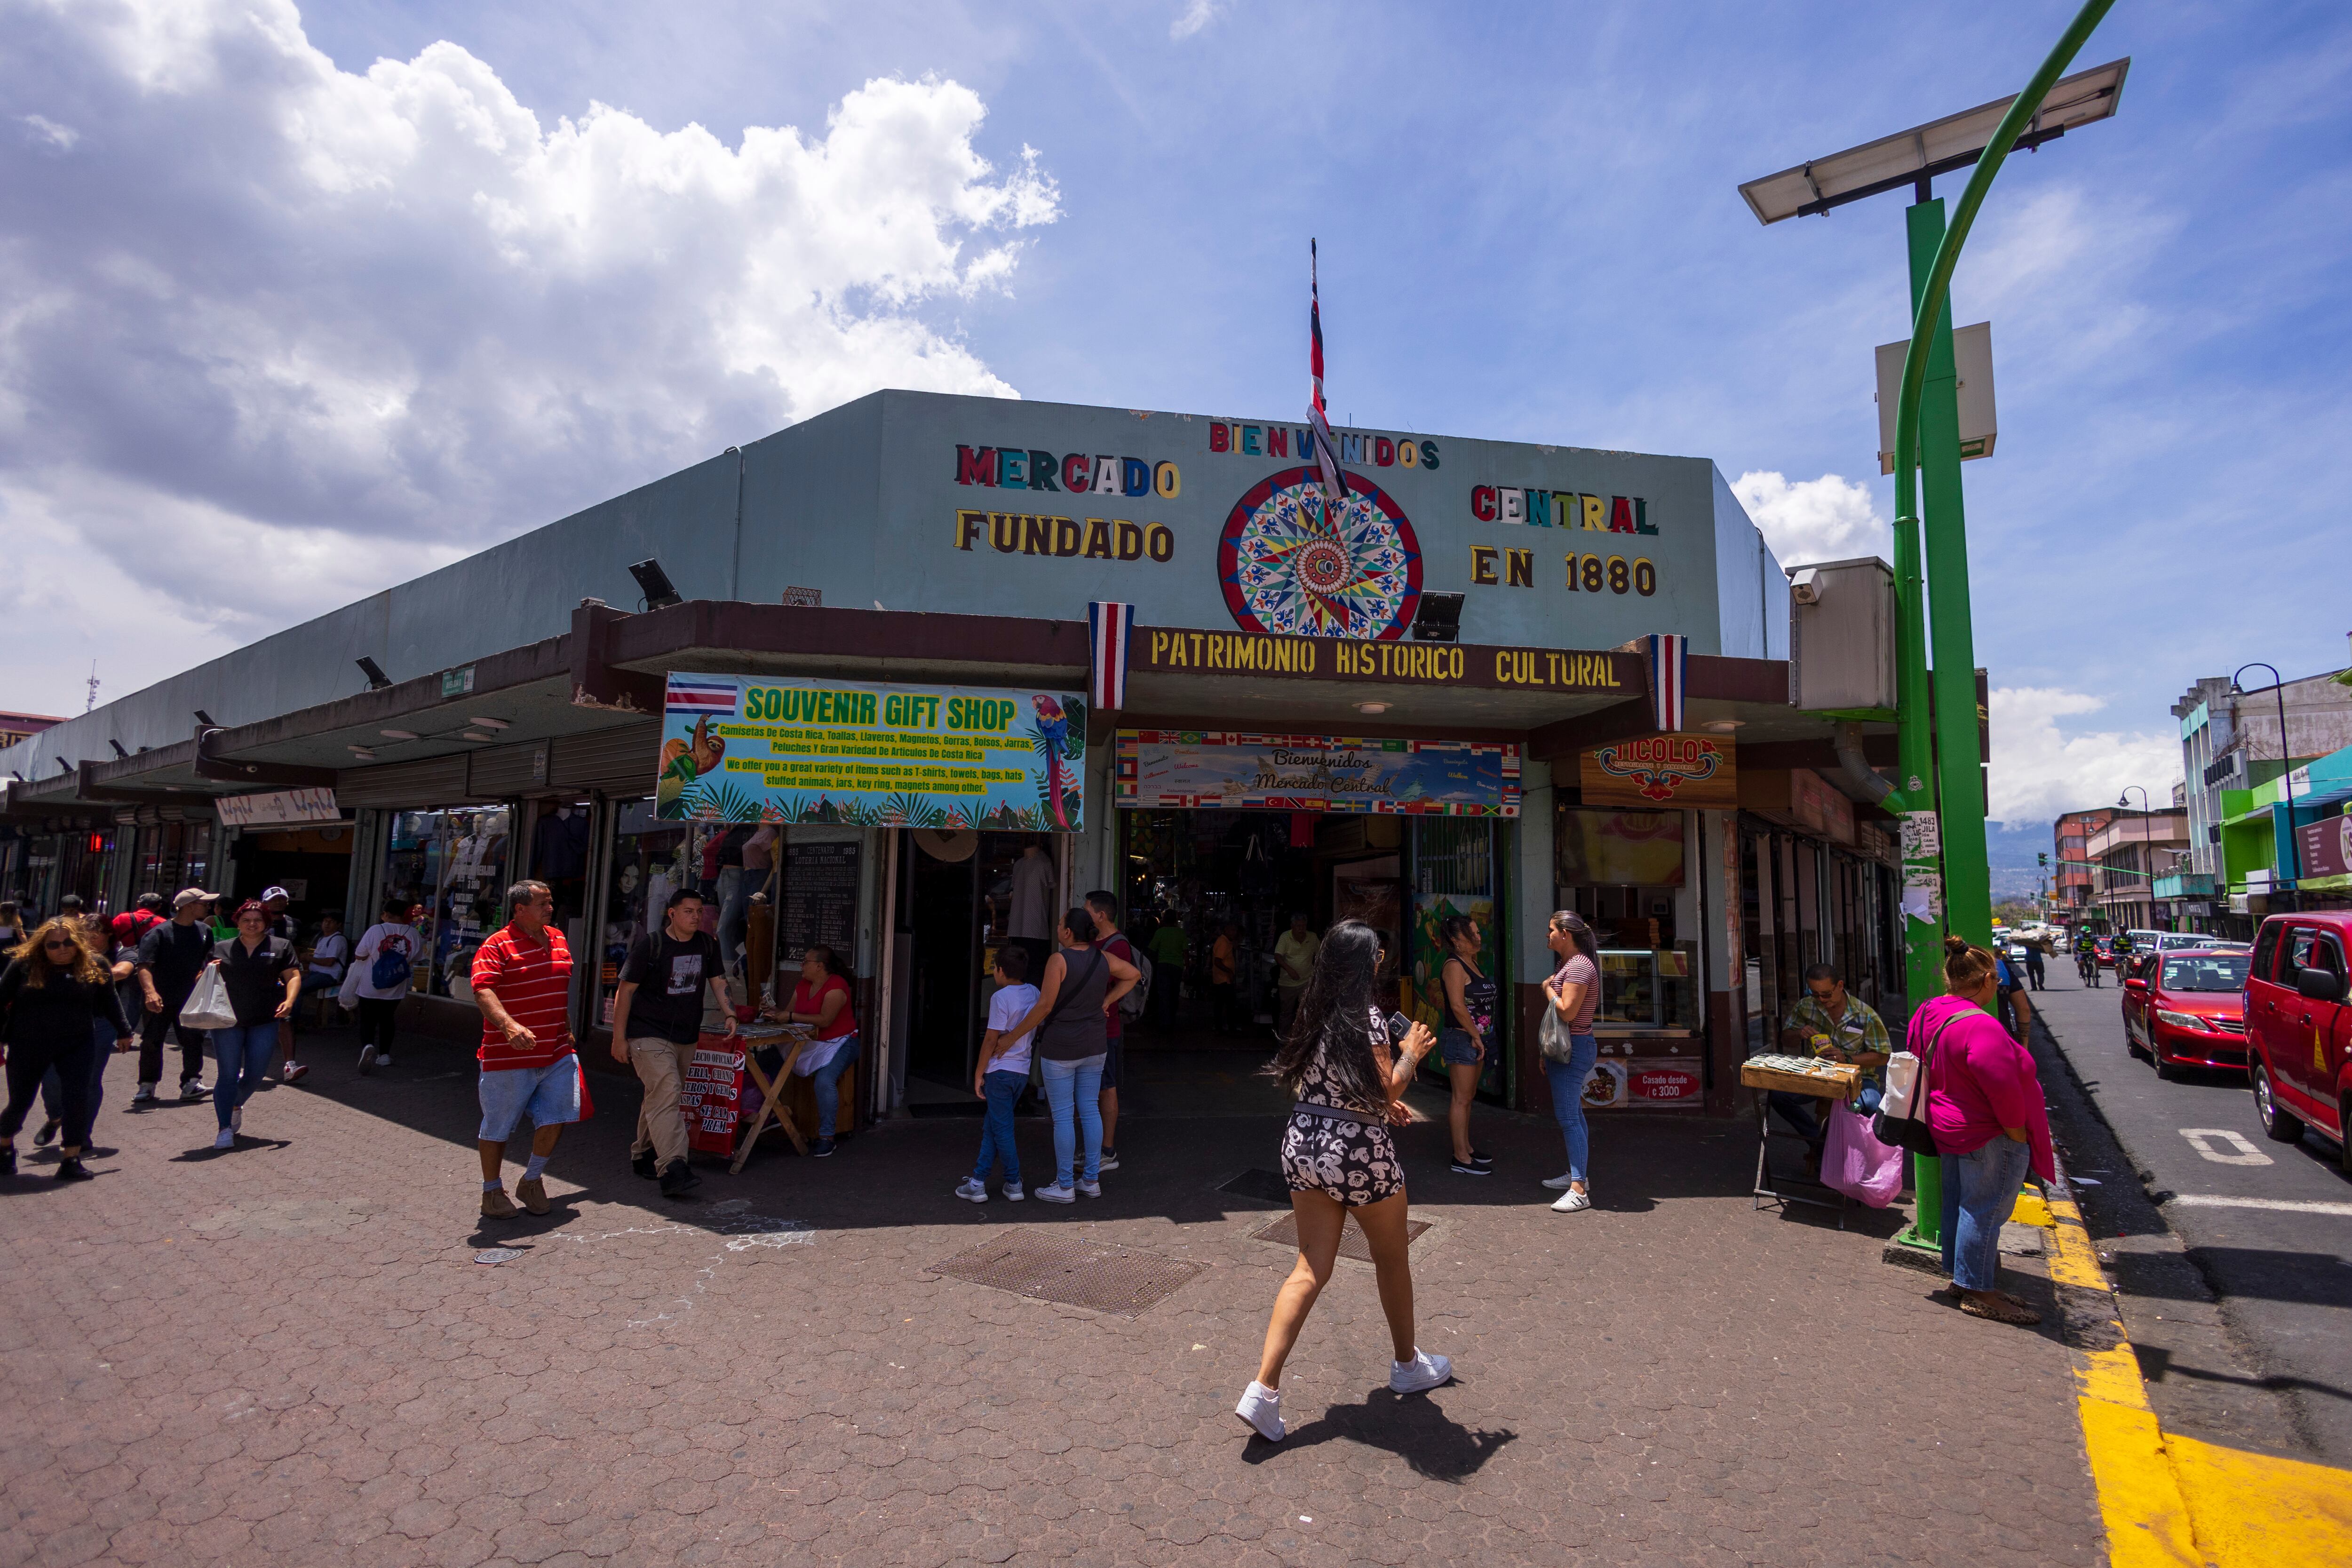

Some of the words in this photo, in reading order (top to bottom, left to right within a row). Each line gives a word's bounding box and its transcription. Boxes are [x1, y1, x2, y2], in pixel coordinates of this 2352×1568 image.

[954, 444, 1180, 500] MERCADO
[1471, 484, 1660, 537] CENTRAL
[953, 509, 1174, 563] FUNDADO
[1469, 544, 1534, 589] EN
[1566, 551, 1657, 597] 1880
[1151, 631, 1316, 673] PATRIMONIO
[1335, 640, 1464, 681] HISTORICO
[1496, 651, 1621, 688] CULTURAL
[746, 688, 876, 724] SOUVENIR
[885, 695, 939, 727] GIFT
[948, 698, 1015, 730] SHOP
[720, 726, 764, 737] Camisetas
[767, 728, 777, 737] De
[779, 729, 803, 739] Costa
[806, 730, 825, 741] Rica,
[827, 731, 857, 742] Toallas,
[860, 732, 897, 743] Llaveros,
[900, 734, 941, 745] Magnetos,
[944, 736, 971, 747] Gorras,
[974, 738, 1002, 748] Bolsos,
[1005, 739, 1031, 749] Jarras,
[773, 742, 810, 752] Peluches
[814, 744, 818, 753] Y
[821, 745, 838, 754] Gran
[841, 745, 876, 755] Variedad
[879, 747, 889, 756] De
[891, 747, 927, 757] Articulos
[930, 749, 939, 757] De
[942, 749, 963, 759] Costa
[966, 750, 982, 759] Rica
[1272, 748, 1372, 769] Bienvenidos
[727, 760, 739, 769] We
[742, 761, 762, 770] offer
[764, 763, 779, 772] you
[790, 763, 812, 772] great
[815, 764, 842, 774] variety
[845, 765, 853, 774] of
[856, 765, 878, 775] items
[881, 767, 900, 776] such
[915, 767, 947, 778] T-shirts,
[950, 769, 979, 779] towels,
[982, 770, 1002, 780] bags,
[1005, 771, 1022, 780] hats
[766, 776, 796, 785] stuffed
[799, 777, 833, 788] animals,
[836, 778, 854, 788] jars,
[857, 779, 871, 789] key
[874, 780, 892, 790] ring,
[895, 780, 930, 791] magnets
[932, 783, 959, 792] among
[961, 783, 985, 792] other.
[1255, 773, 1325, 790] Mercado
[1330, 777, 1393, 793] Central
[693, 1052, 710, 1061] ECIO
[712, 1054, 732, 1064] OFICIAL
[708, 1083, 715, 1094] Y
[1643, 1075, 1666, 1084] Casado
[1668, 1075, 1687, 1084] desde
[1659, 1085, 1679, 1097] 3000
